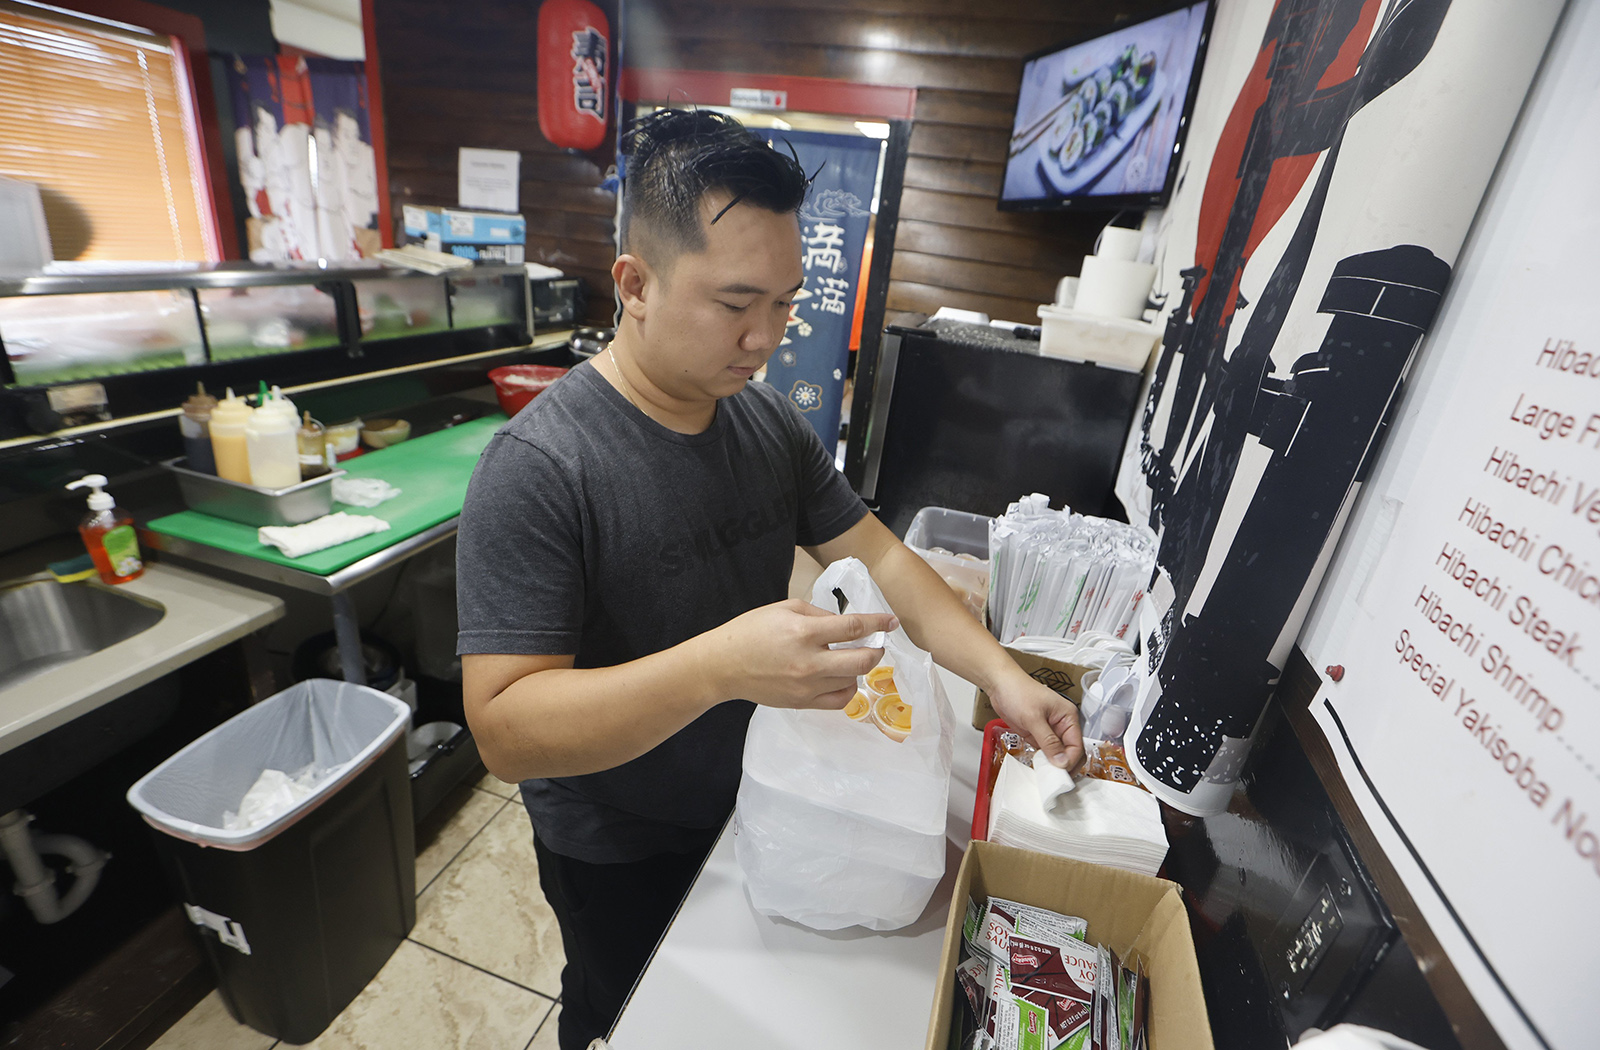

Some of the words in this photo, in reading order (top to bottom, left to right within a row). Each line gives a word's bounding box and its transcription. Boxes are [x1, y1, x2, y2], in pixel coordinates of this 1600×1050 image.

[1510, 393, 1576, 440] Large
[1483, 446, 1571, 505] Hibachi
[1572, 481, 1600, 538] Ve
[1458, 497, 1540, 562] Hibachi
[1435, 542, 1511, 612] Hibachi
[1508, 596, 1583, 668] Steak
[1414, 584, 1484, 658] Hibachi
[1481, 645, 1565, 733] Shrimp
[1395, 629, 1455, 702] Special
[1454, 687, 1551, 809] Yakisoba
[1552, 798, 1600, 878] No
[969, 963, 987, 977] UCE
[985, 930, 1010, 952] SAU
[1079, 969, 1097, 983] OY
